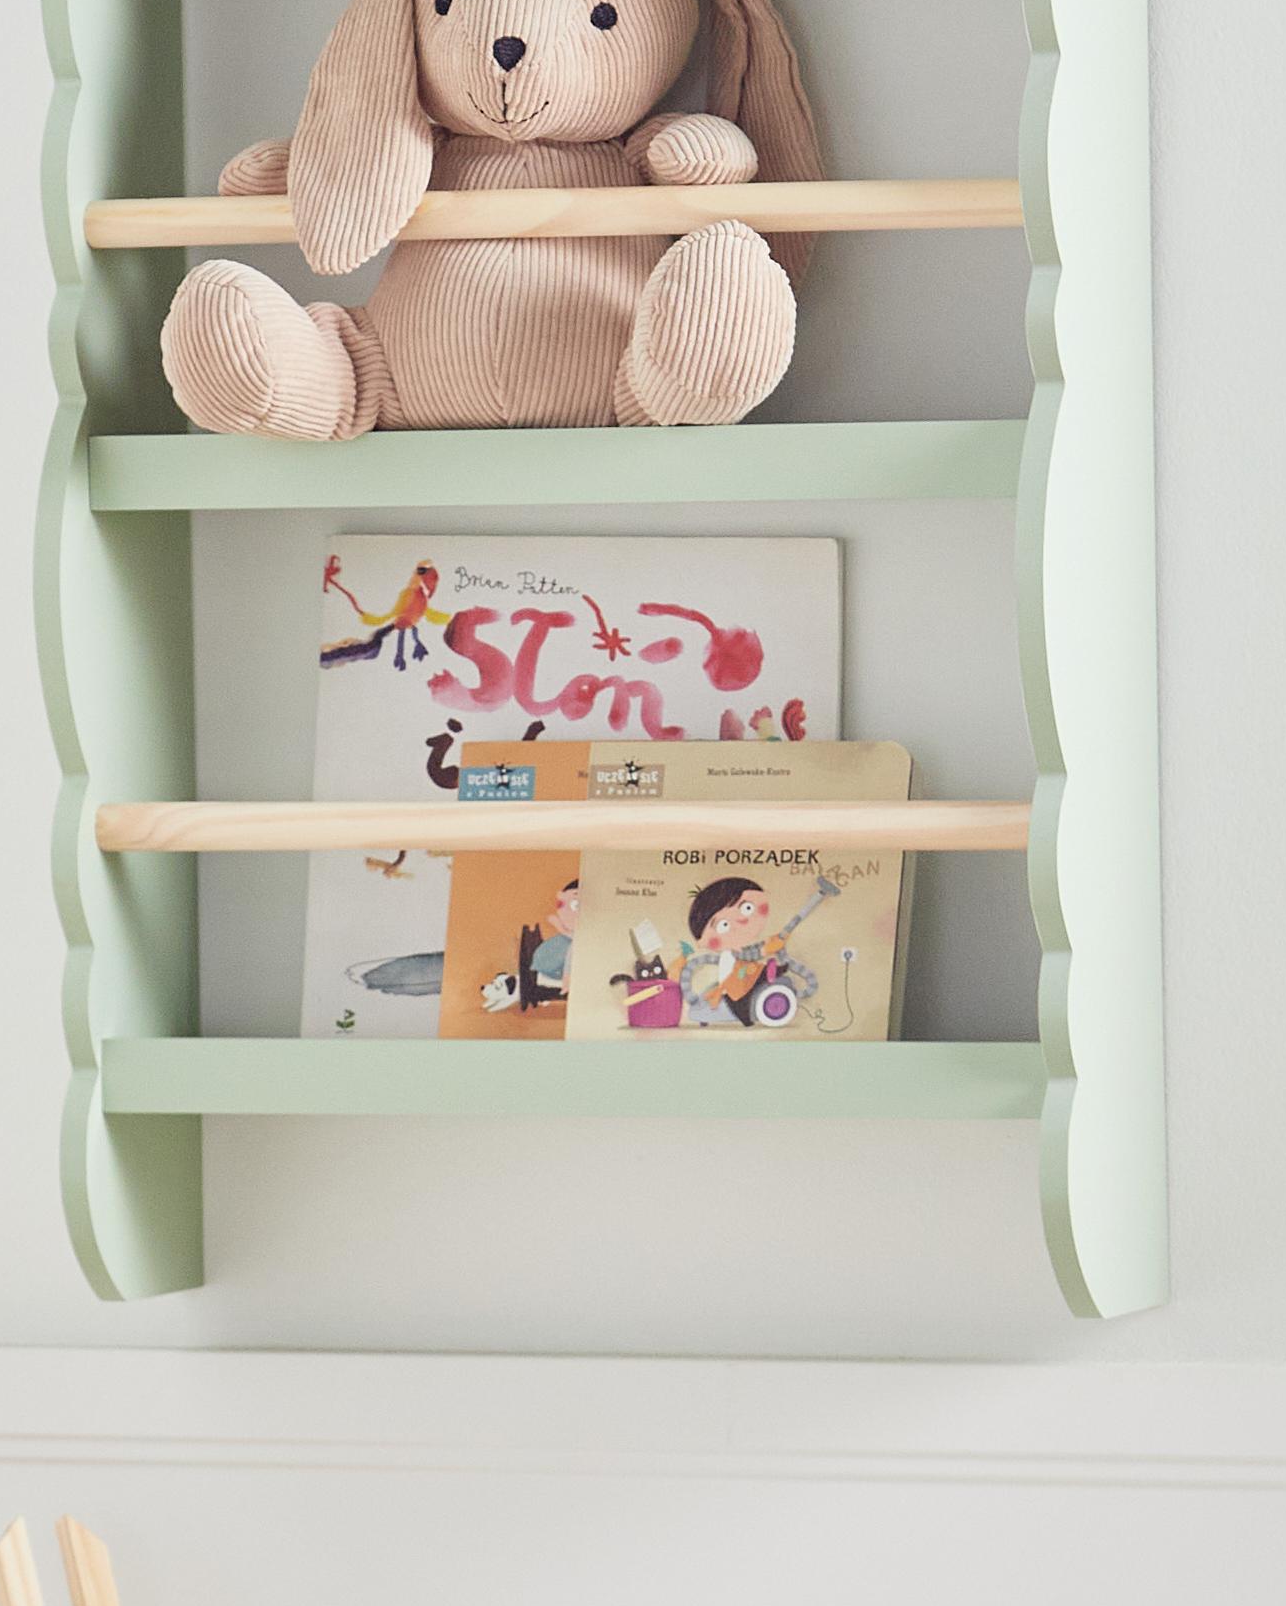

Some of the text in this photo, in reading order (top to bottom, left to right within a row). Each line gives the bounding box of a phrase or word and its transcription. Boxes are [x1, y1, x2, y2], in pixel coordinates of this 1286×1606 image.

[454, 566, 579, 595] Brian Patten
[715, 848, 821, 867] PORZĄDEK
